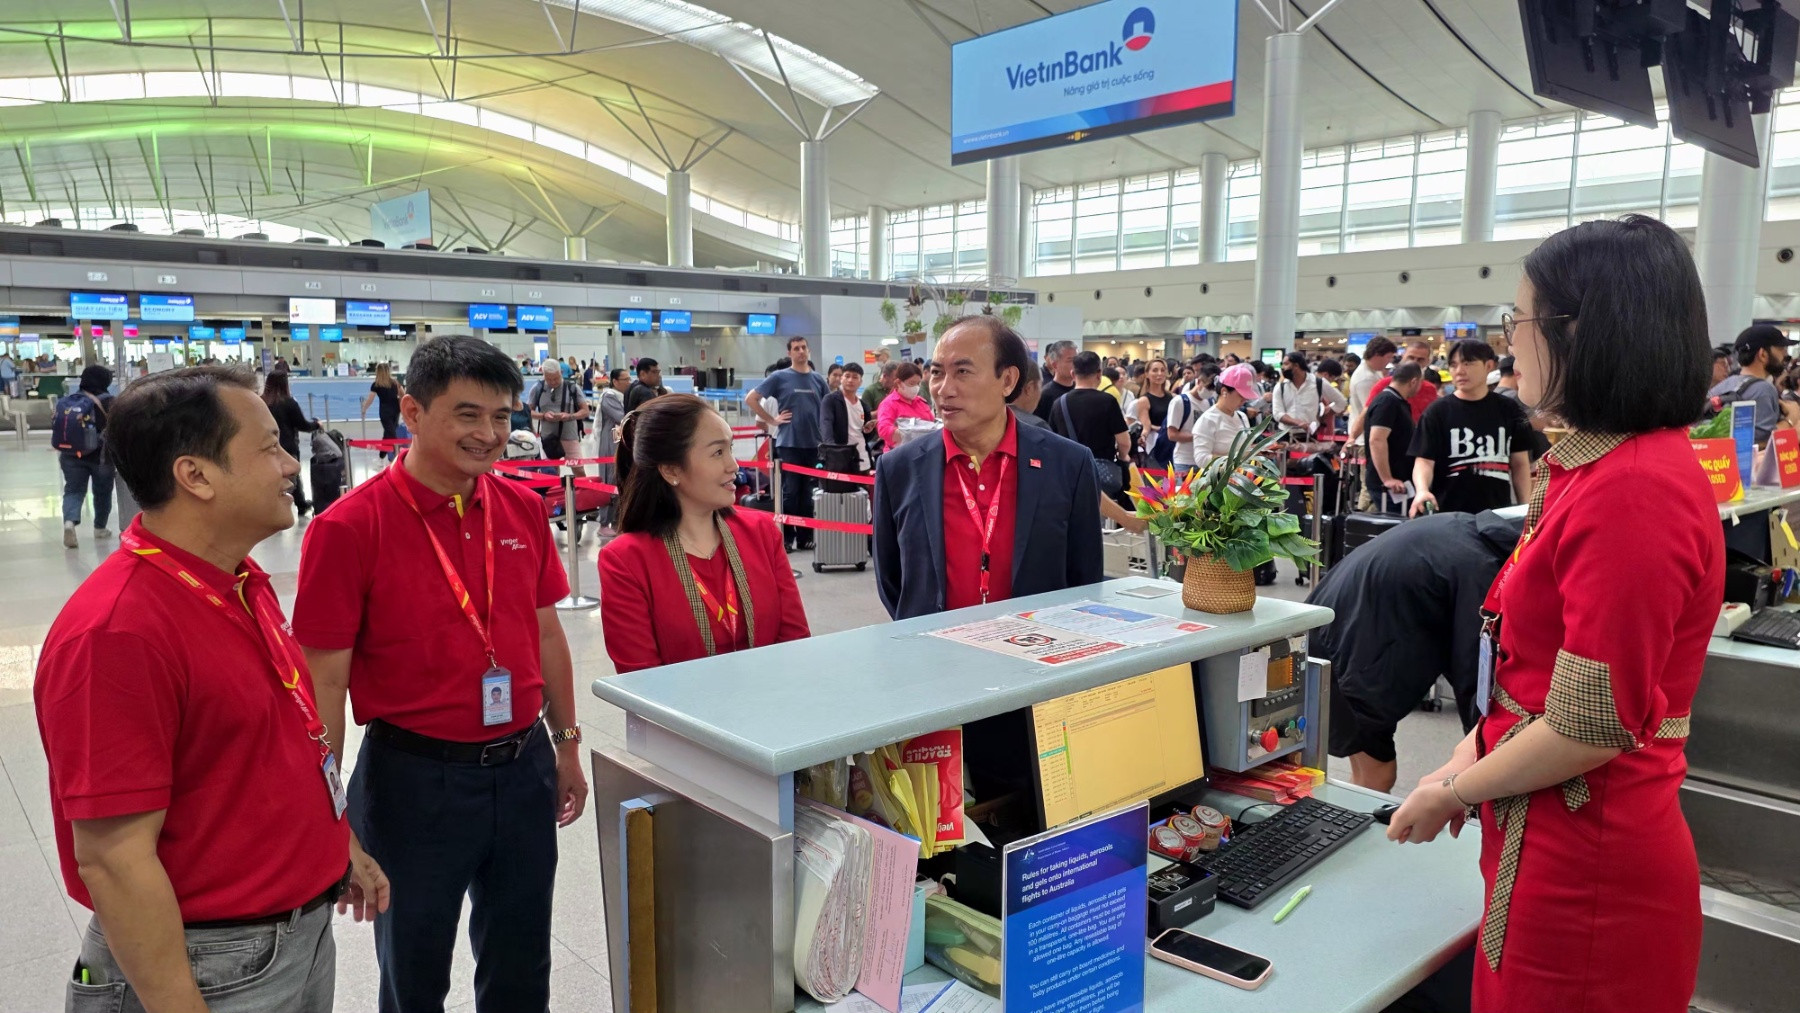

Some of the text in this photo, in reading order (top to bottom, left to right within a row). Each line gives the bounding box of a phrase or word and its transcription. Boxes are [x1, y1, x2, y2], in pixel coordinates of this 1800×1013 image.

[1006, 41, 1124, 90] VietinBank
[1708, 473, 1726, 484] LOSED
[1022, 870, 1038, 881] Rules
[1050, 860, 1067, 870] taking
[1068, 853, 1088, 863] liquids,
[1089, 842, 1112, 856] aerosols
[1022, 858, 1097, 892] and gels onto international
[1021, 890, 1040, 902] flights
[1049, 878, 1074, 892] Australia
[1028, 920, 1041, 929] Each
[1042, 911, 1064, 924] container
[1070, 902, 1085, 912] liquids,
[1088, 894, 1106, 906] aerosols
[1107, 889, 1116, 898] and
[1116, 886, 1126, 895] gels
[1035, 927, 1046, 936] your
[1047, 918, 1066, 930] carry-on
[1068, 910, 1088, 922] baggage
[1089, 904, 1100, 913] must
[1109, 894, 1125, 905] exceed
[1032, 955, 1120, 998] baby products under certain conditions.
[1040, 978, 1049, 986] can
[1058, 969, 1071, 978] carry
[1079, 958, 1092, 969] board
[1093, 949, 1115, 962] medicines
